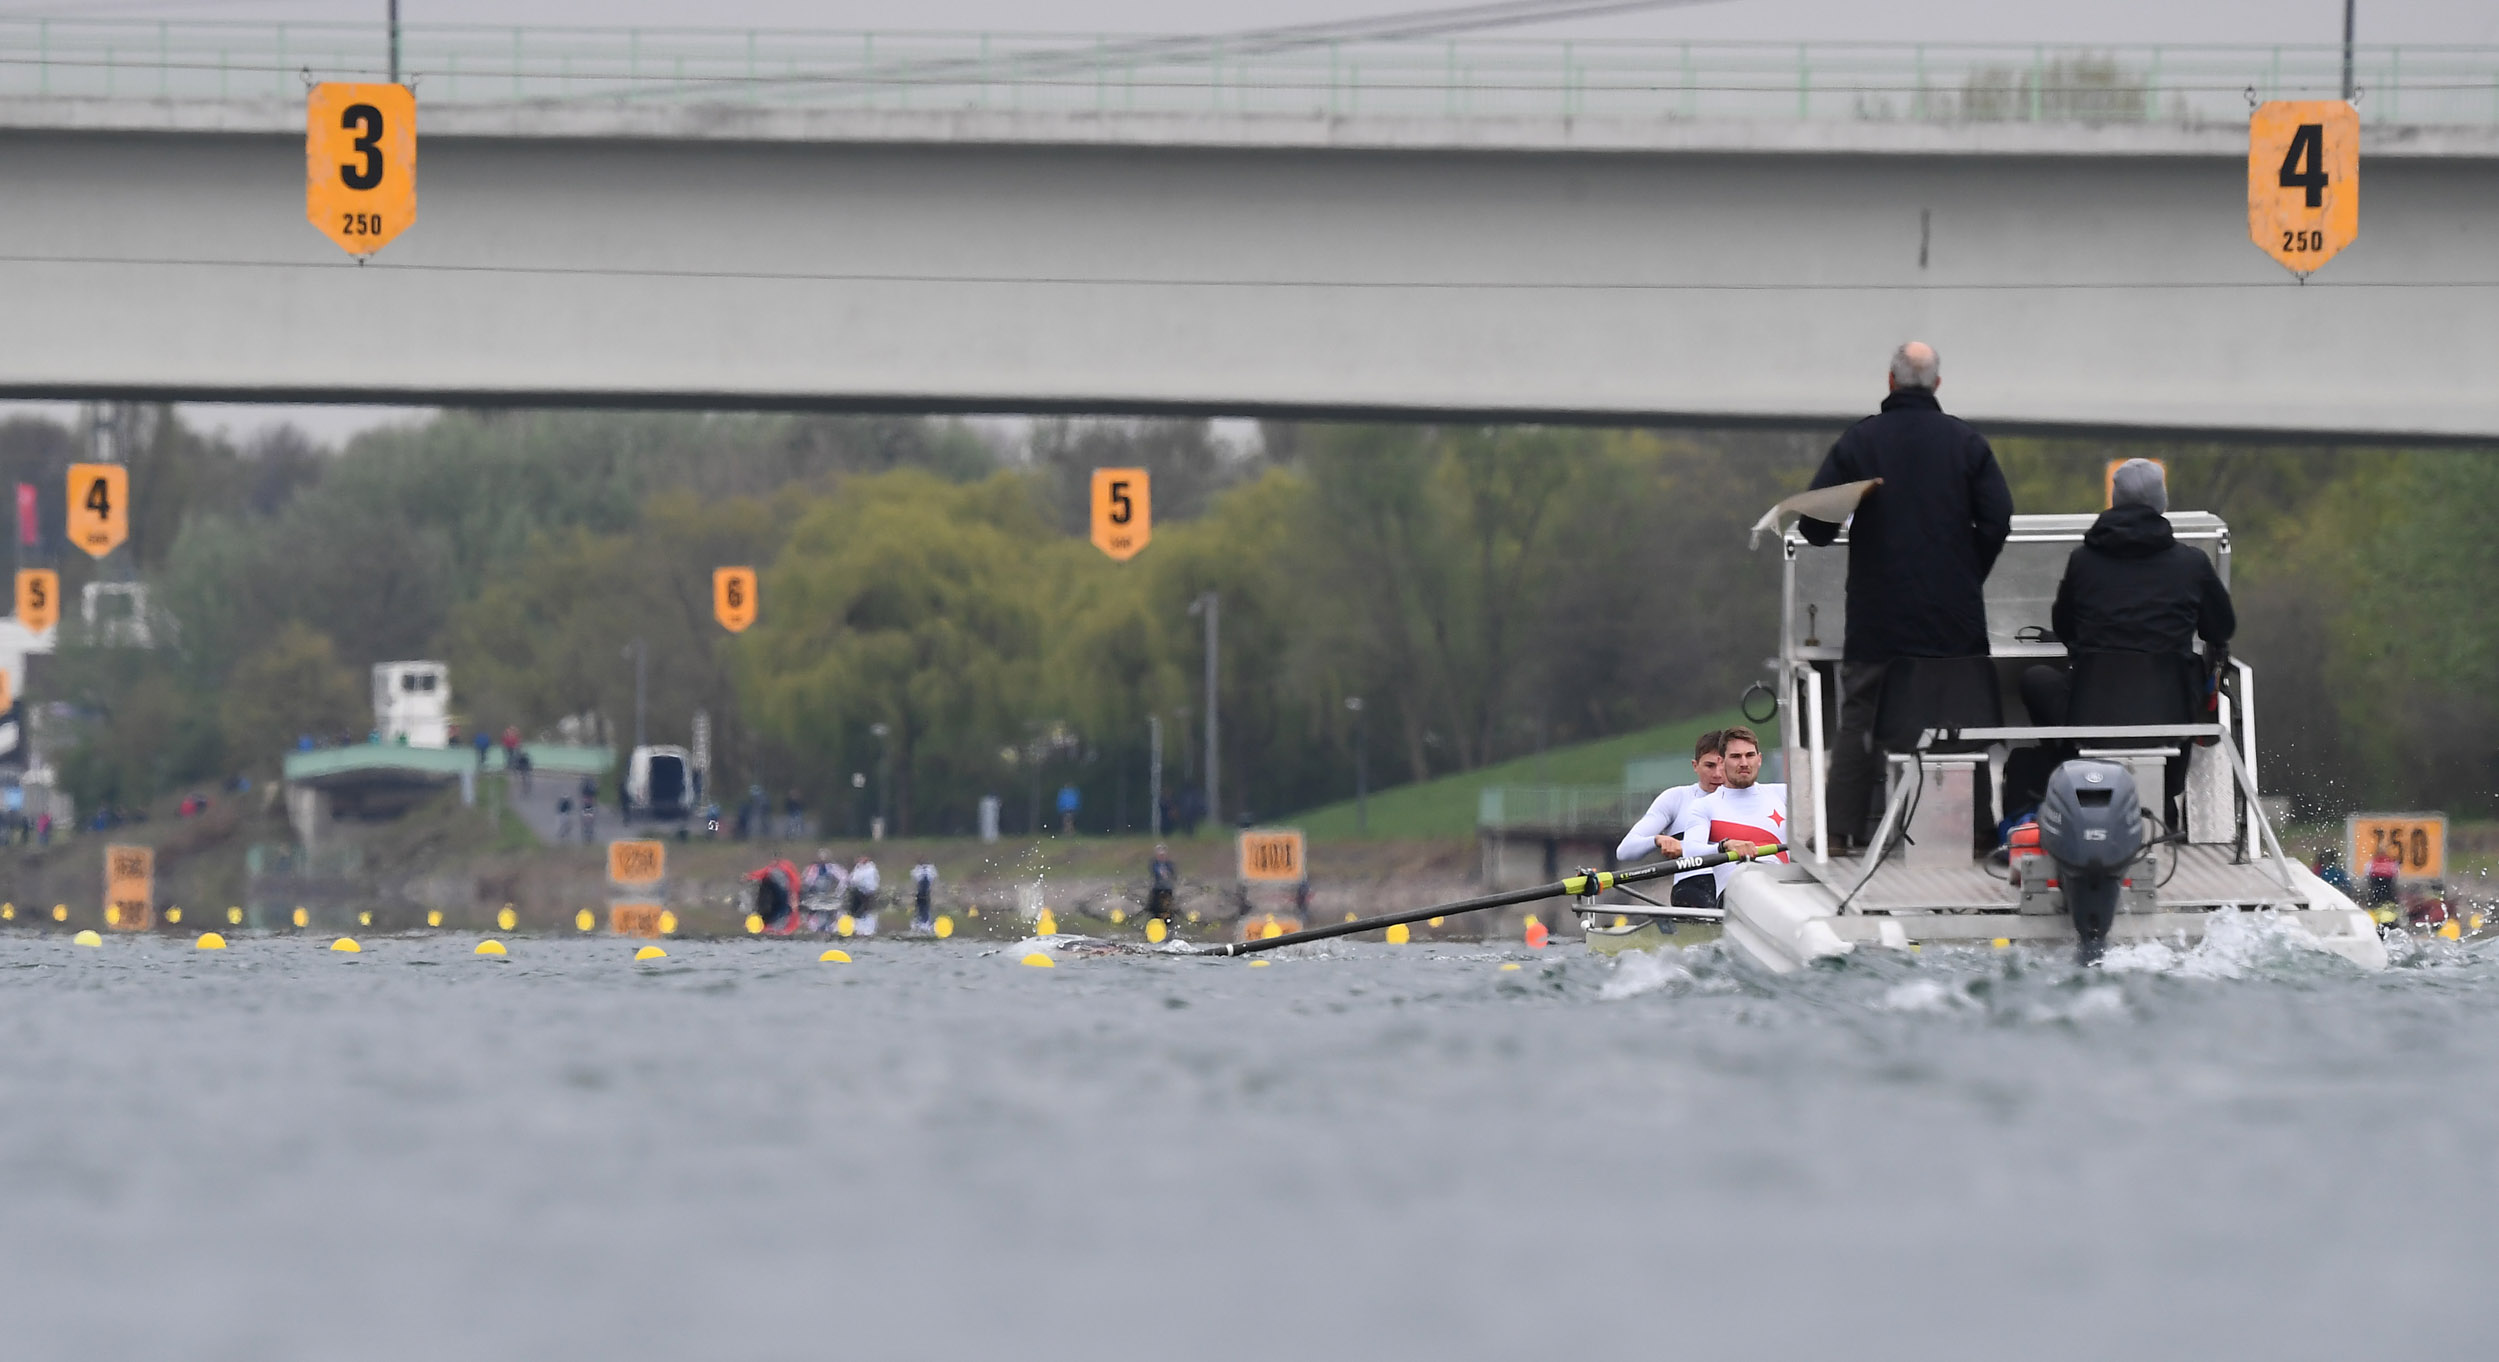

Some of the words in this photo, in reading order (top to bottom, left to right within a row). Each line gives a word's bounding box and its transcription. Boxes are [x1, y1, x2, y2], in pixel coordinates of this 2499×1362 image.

[341, 104, 383, 190] 3
[2279, 124, 2329, 207] 4
[342, 214, 382, 235] 250
[2282, 231, 2323, 251] 250
[86, 478, 110, 520] 4
[1110, 481, 1131, 524] 5
[728, 578, 743, 608] 6
[2084, 828, 2107, 841] 15
